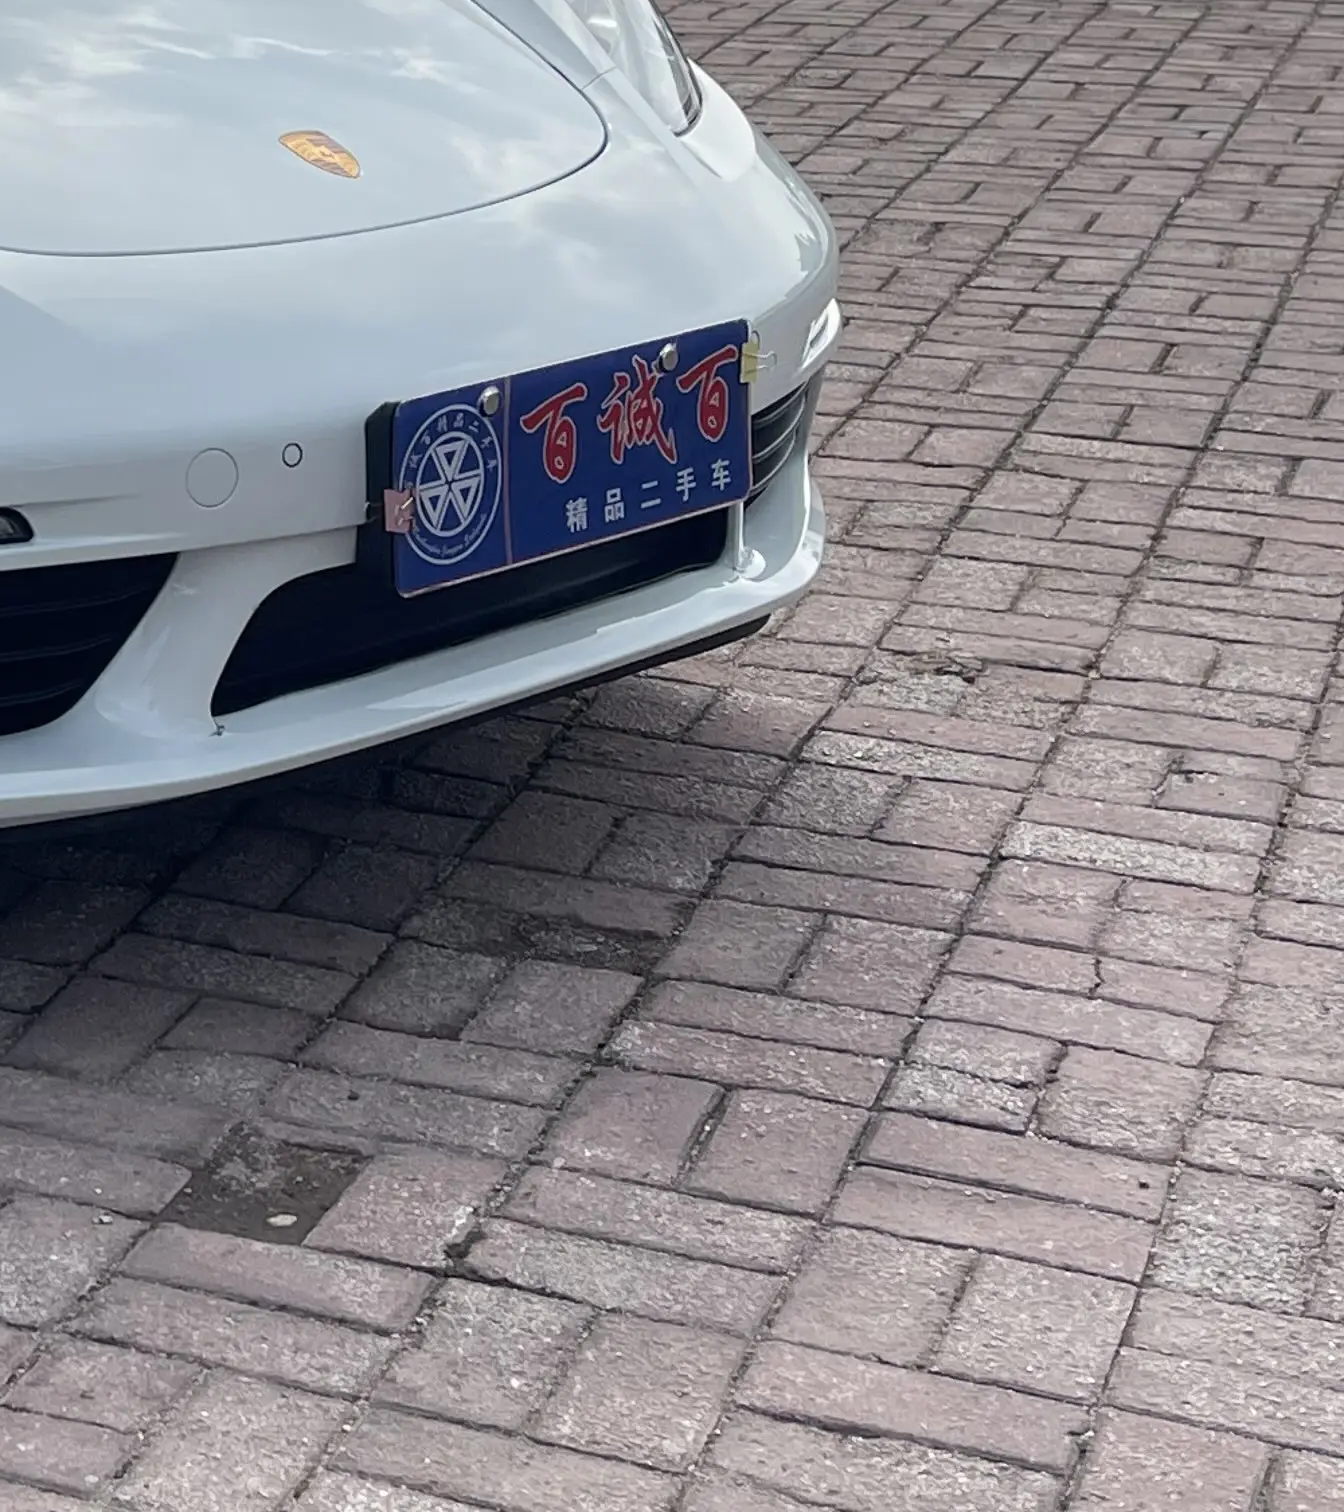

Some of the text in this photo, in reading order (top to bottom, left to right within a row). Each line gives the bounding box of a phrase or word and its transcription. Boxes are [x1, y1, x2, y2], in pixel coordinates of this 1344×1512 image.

[565, 458, 732, 533] 精品二手车
